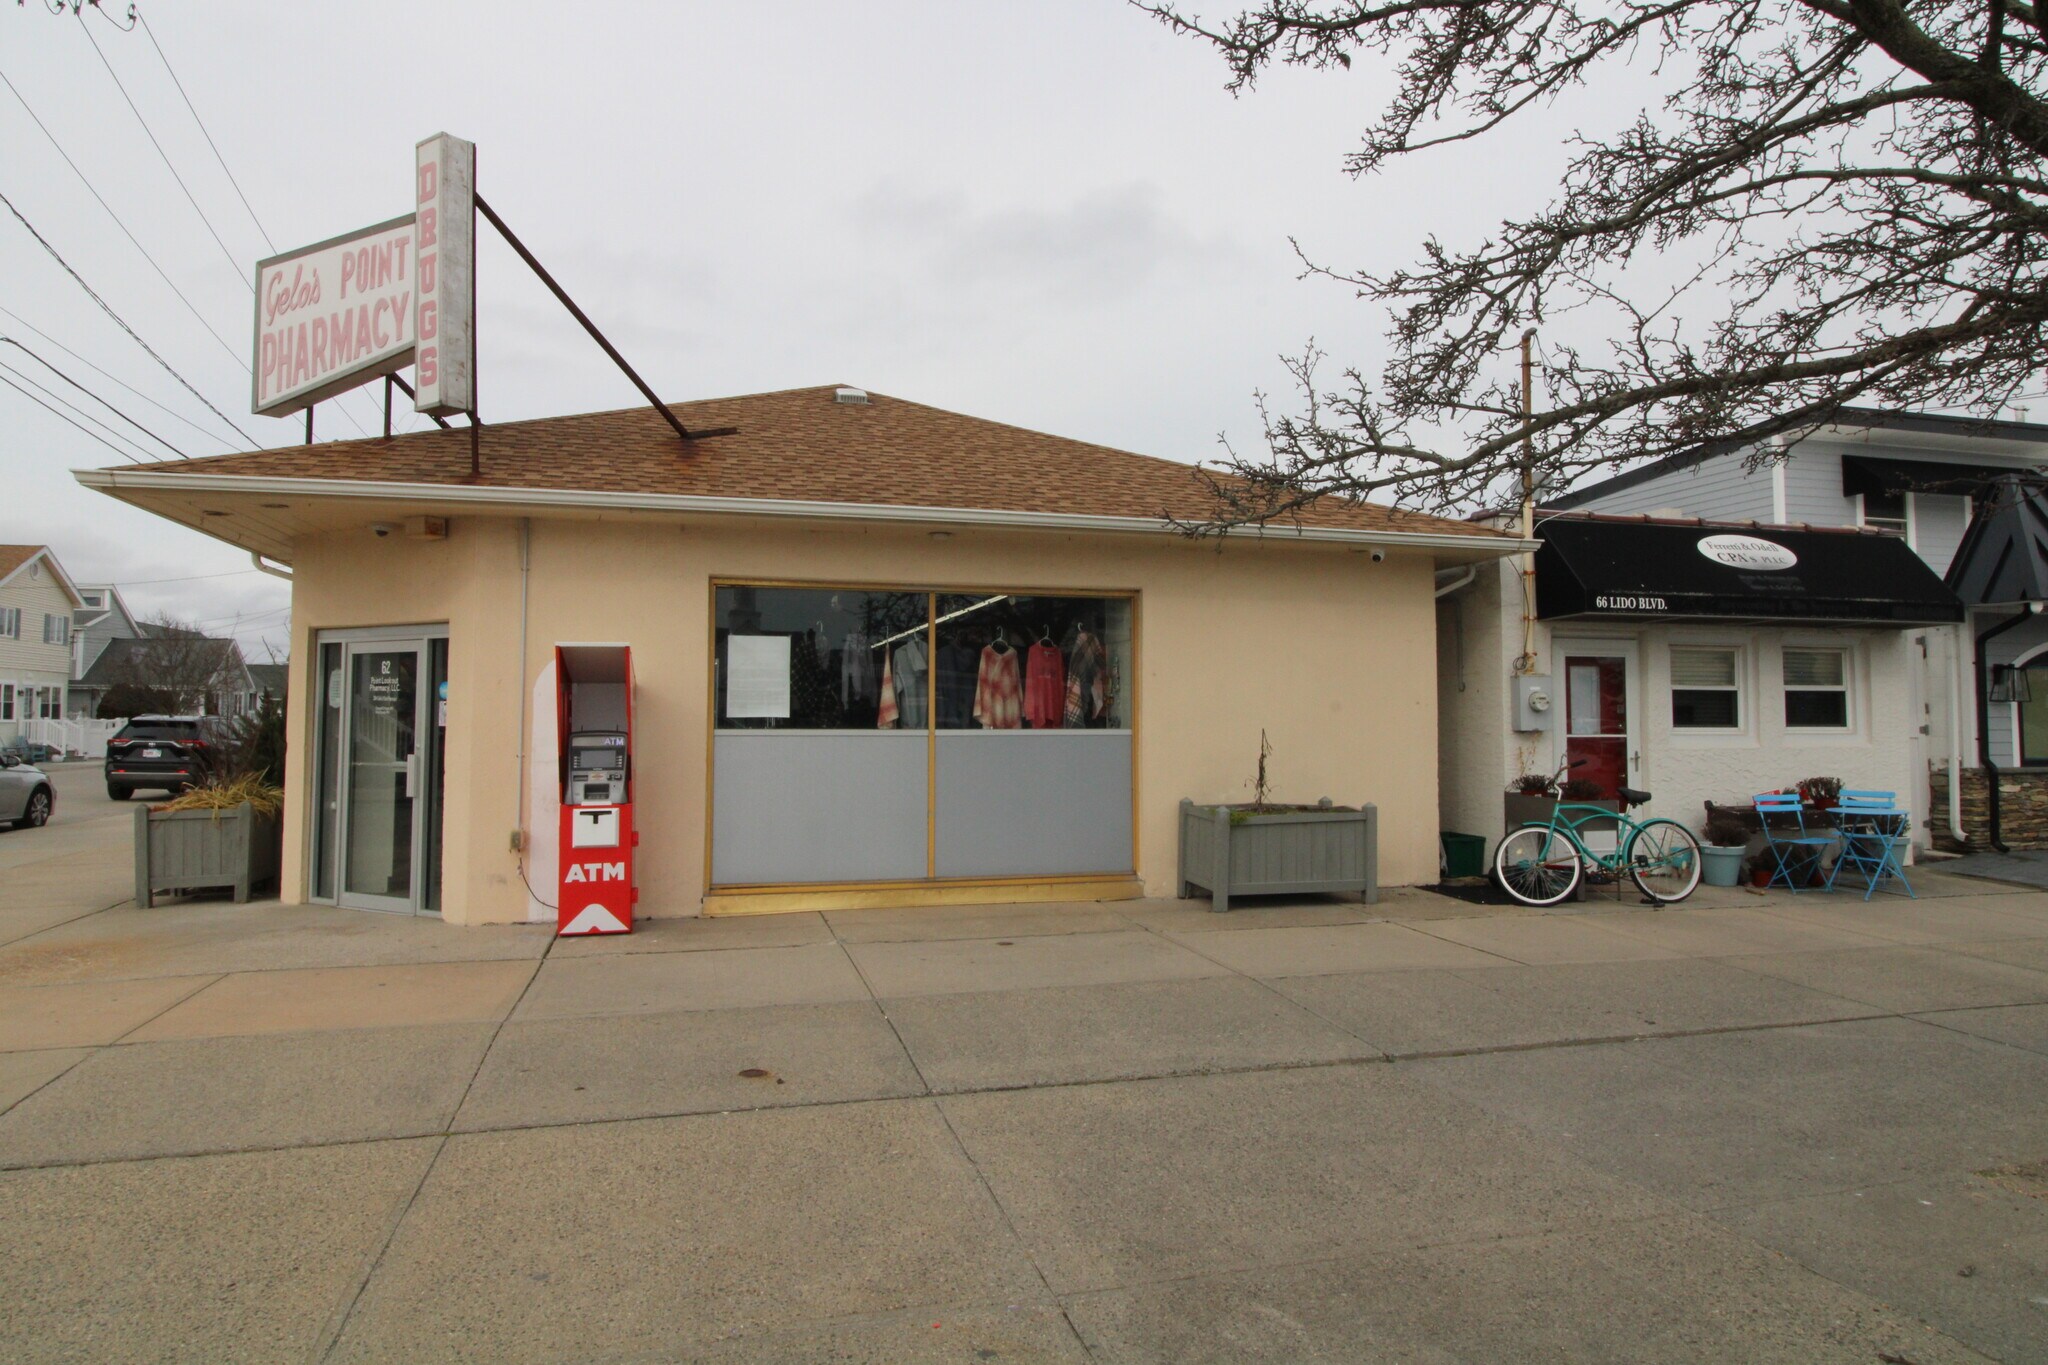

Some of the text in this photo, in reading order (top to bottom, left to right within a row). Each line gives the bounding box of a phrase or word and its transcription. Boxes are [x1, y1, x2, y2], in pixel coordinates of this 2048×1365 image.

[265, 235, 410, 326] Gelo's POINT
[419, 161, 437, 387] DRUGS
[261, 291, 410, 400] PHARMACY
[1706, 541, 1779, 552] Ferretti & Odell
[1717, 552, 1758, 563] CPA's
[1596, 596, 1668, 610] 66 LIDO BLVD.
[381, 660, 391, 674] 62
[604, 736, 624, 746] ATM
[564, 862, 625, 883] ATM
